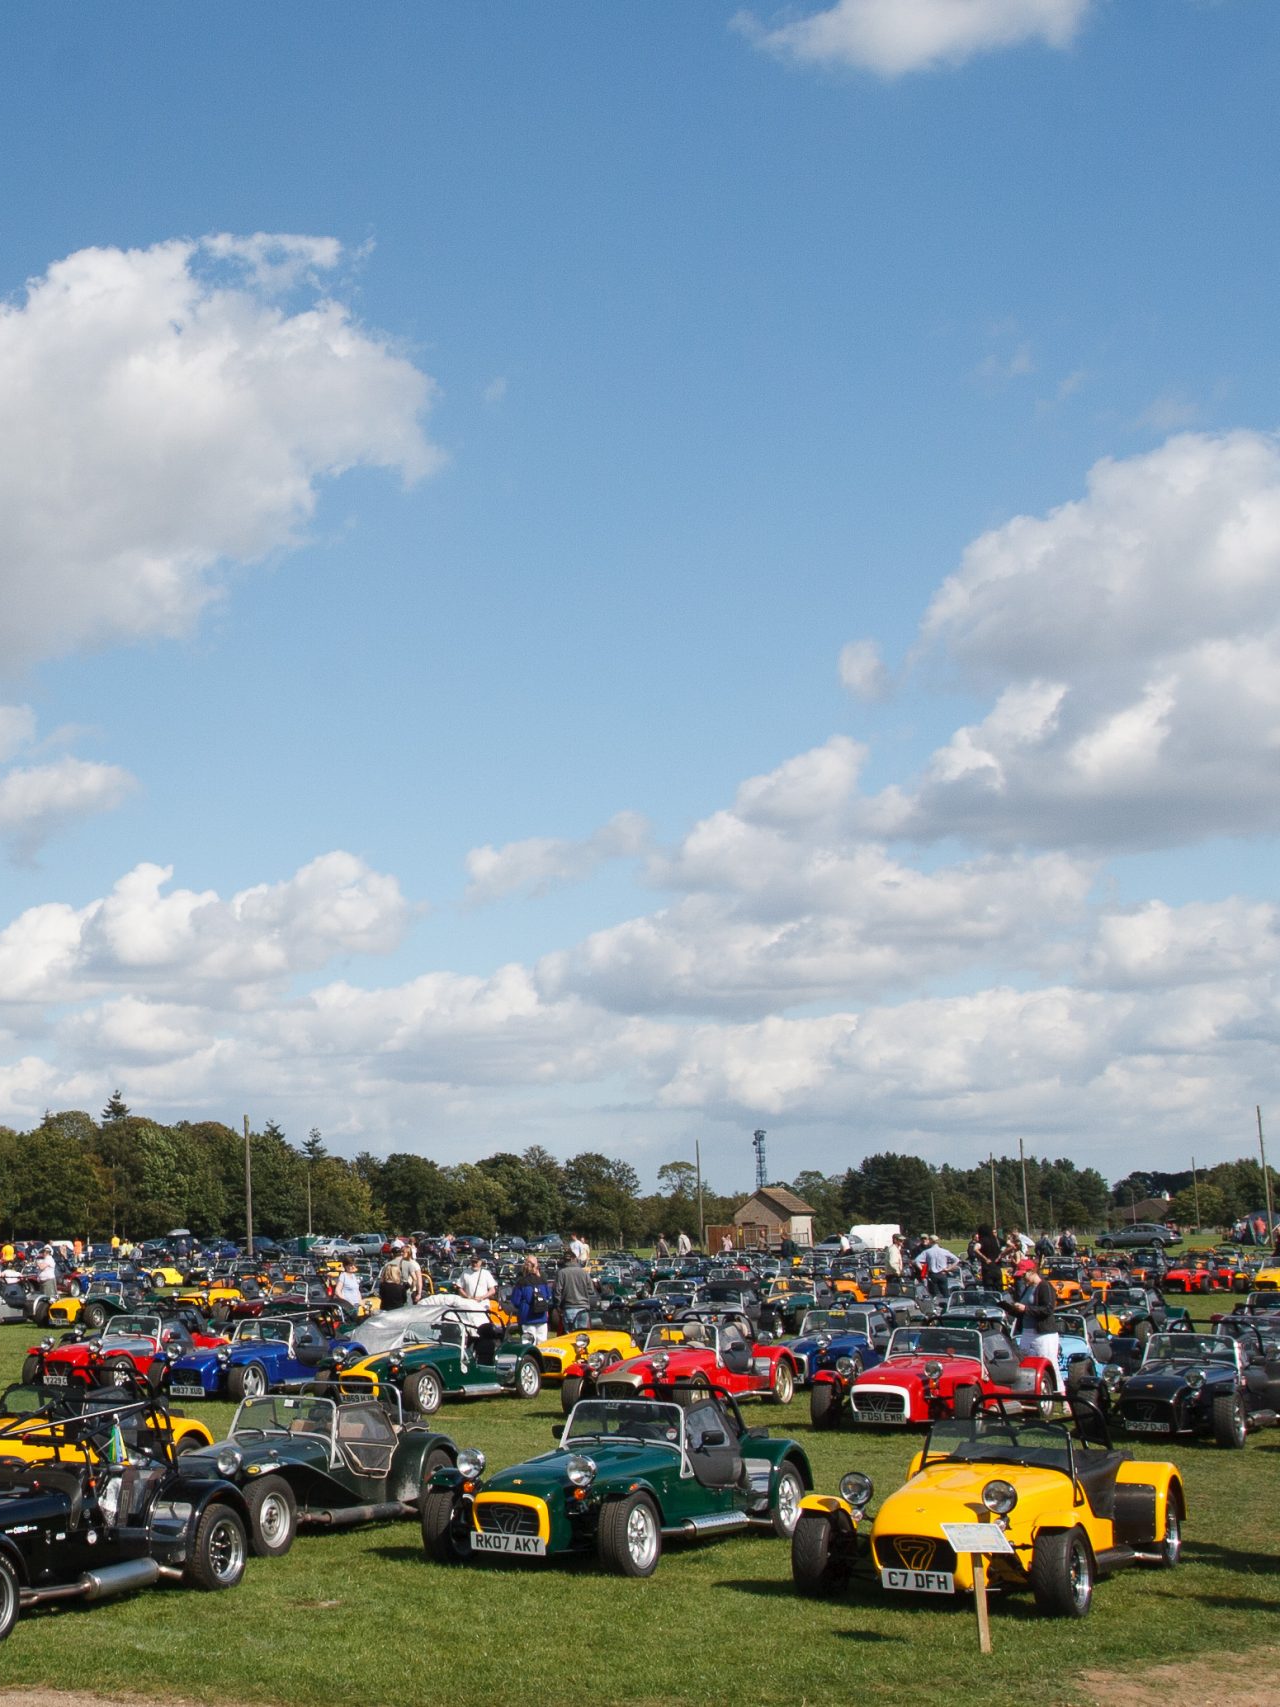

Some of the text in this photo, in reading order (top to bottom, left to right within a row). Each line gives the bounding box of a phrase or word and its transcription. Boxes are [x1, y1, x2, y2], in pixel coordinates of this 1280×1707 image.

[1136, 1402, 1157, 1421] 7
[475, 1534, 540, 1552] RK07 AKY
[887, 1571, 948, 1591] C7 DFH
